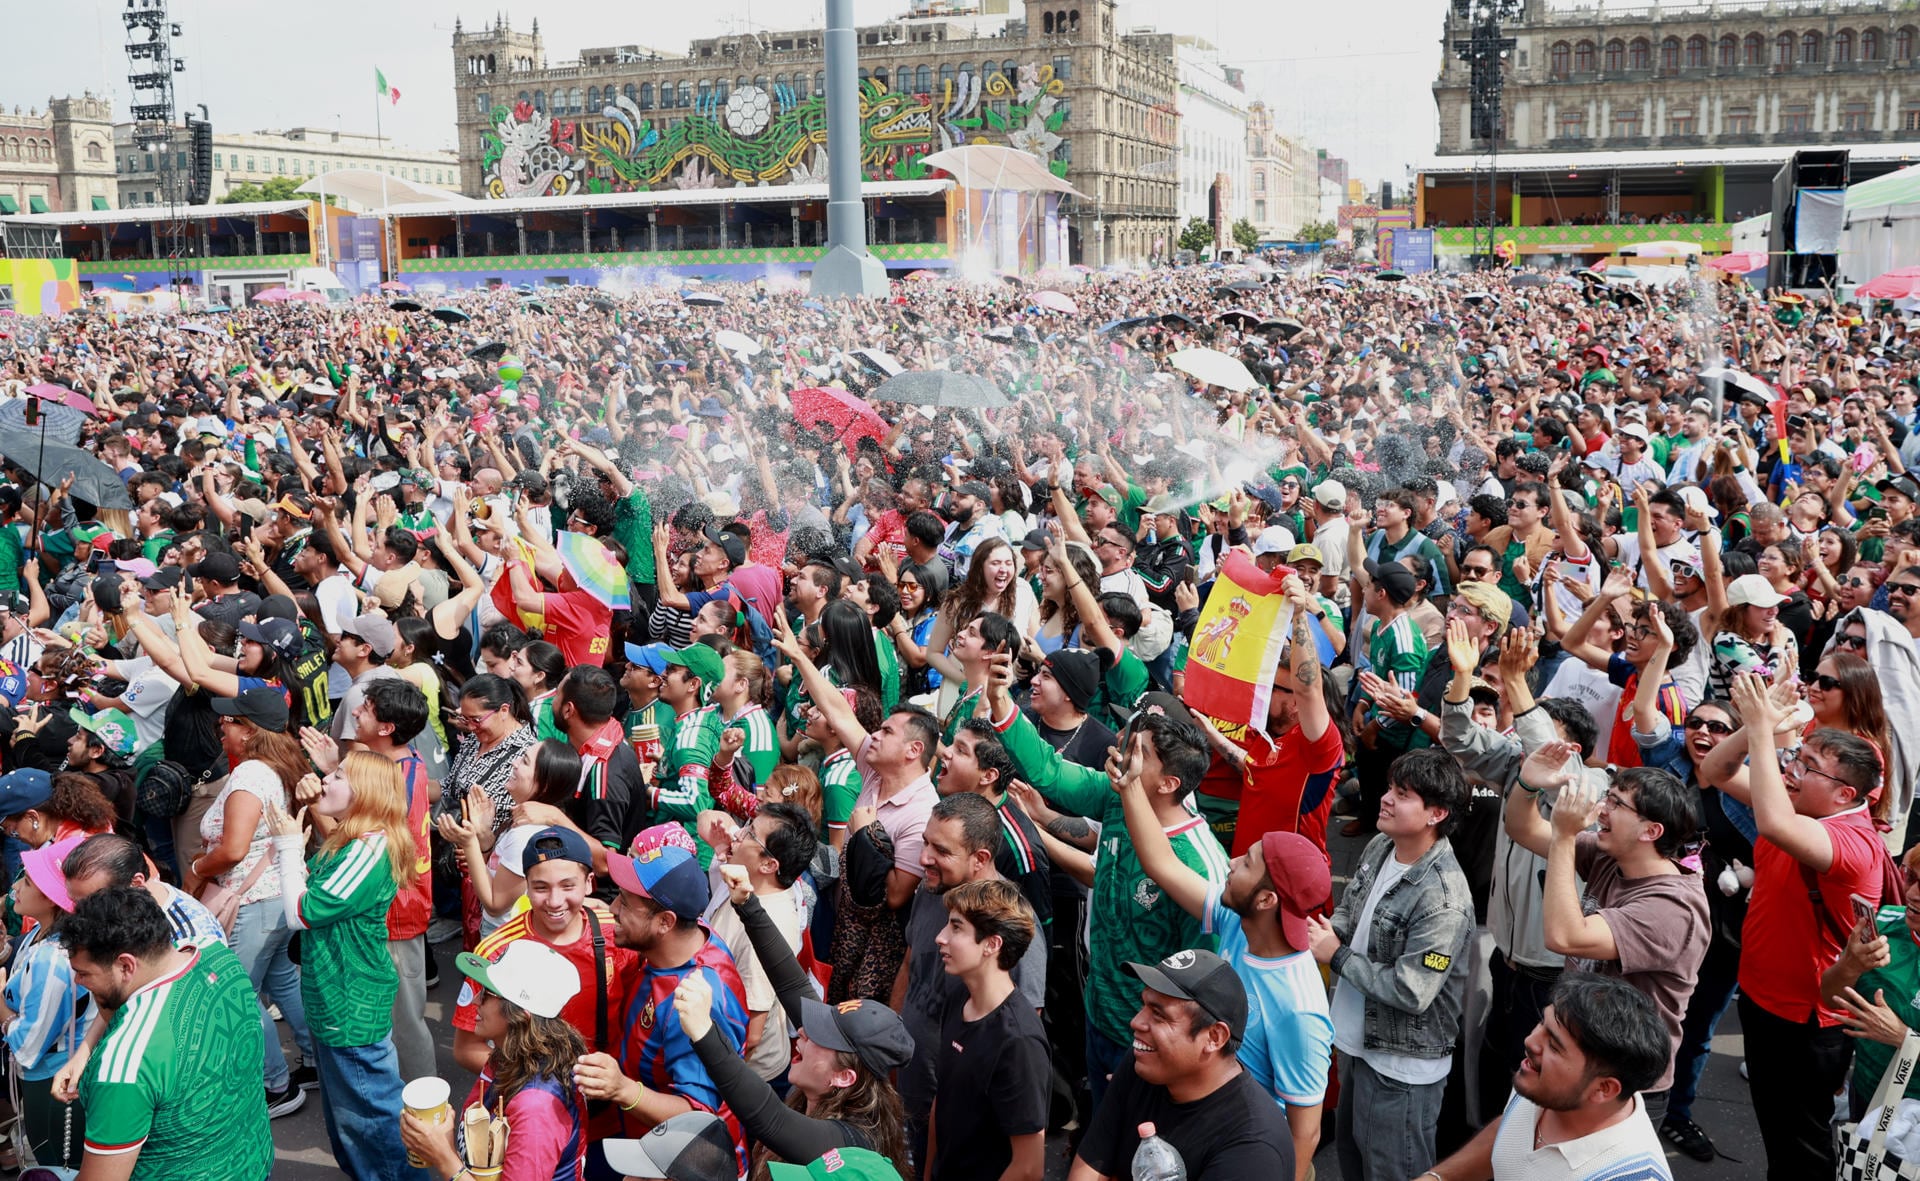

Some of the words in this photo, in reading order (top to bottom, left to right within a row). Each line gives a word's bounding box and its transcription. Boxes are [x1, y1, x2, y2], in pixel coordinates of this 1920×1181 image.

[296, 649, 326, 680] ARLEY
[303, 671, 331, 726] 10
[1424, 957, 1448, 971] WARS
[1893, 1058, 1911, 1086] VANS
[1877, 1105, 1894, 1132] VANS
